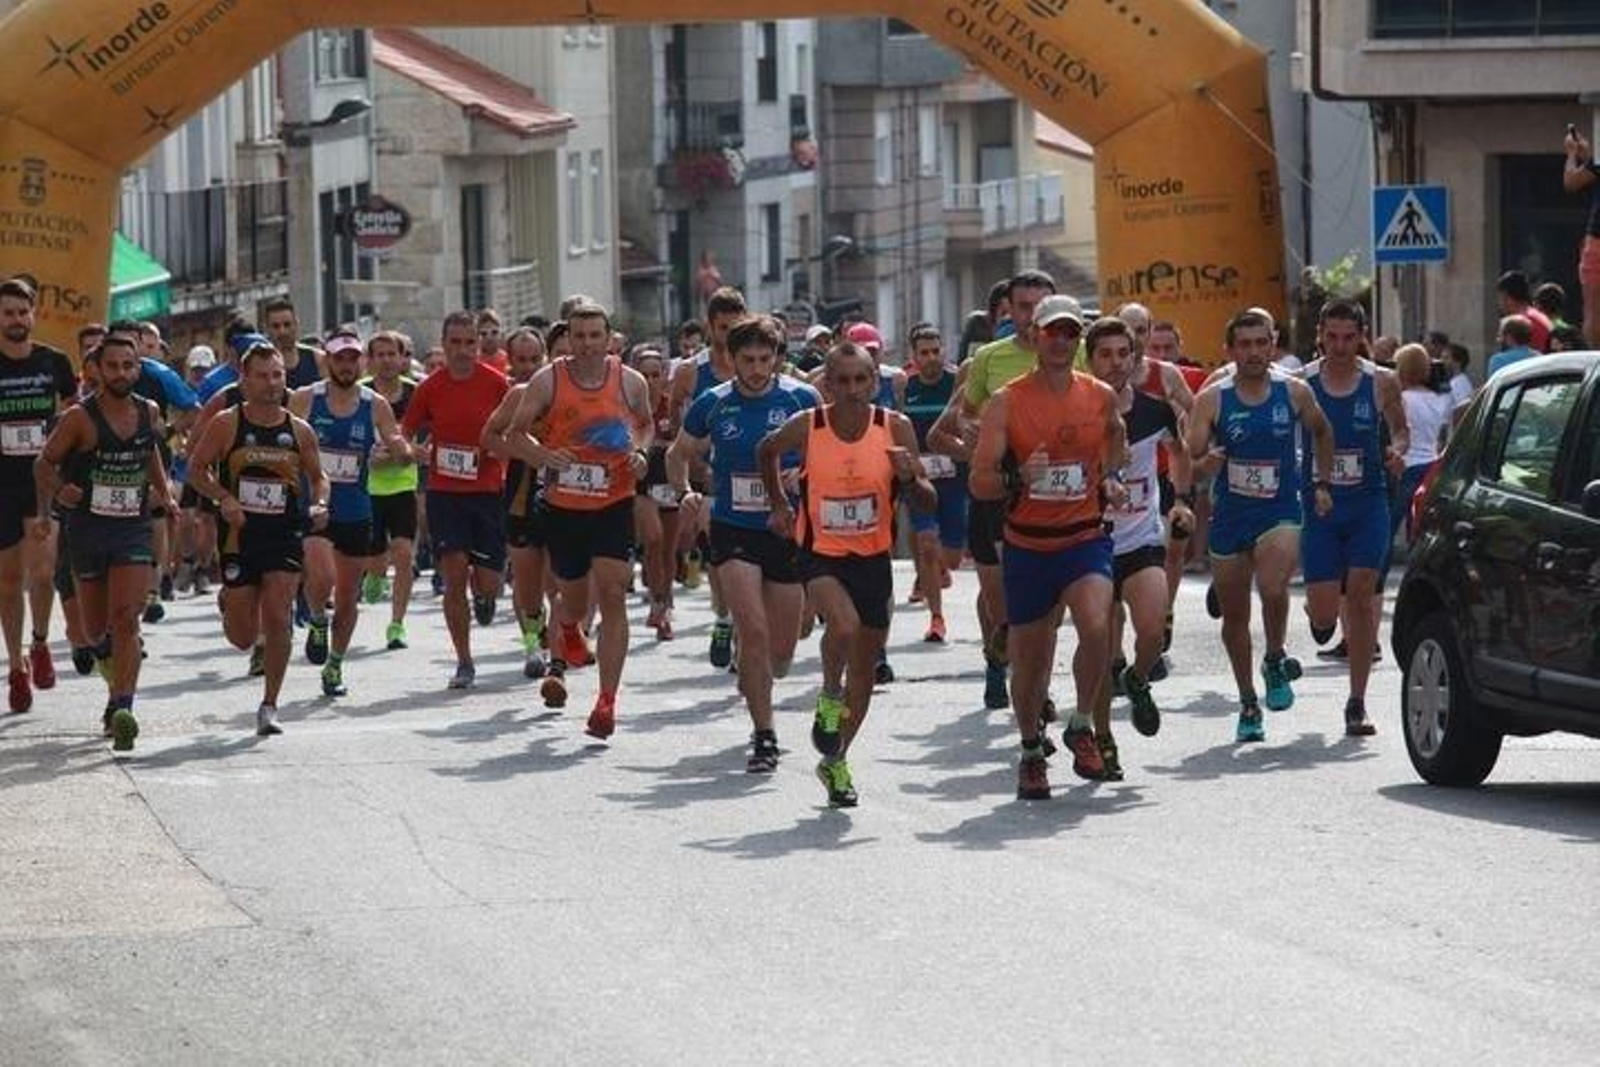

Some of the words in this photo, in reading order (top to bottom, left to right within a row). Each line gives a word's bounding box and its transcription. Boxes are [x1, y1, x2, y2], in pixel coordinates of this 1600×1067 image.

[84, 1, 171, 72] inorde
[945, 7, 1066, 98] OURENSE
[1121, 177, 1184, 198] inorde
[1107, 261, 1239, 297] ourense
[577, 466, 592, 482] 28
[1051, 470, 1069, 486] 32
[1246, 468, 1261, 484] 25
[255, 485, 271, 500] 42
[844, 505, 856, 520] 13
